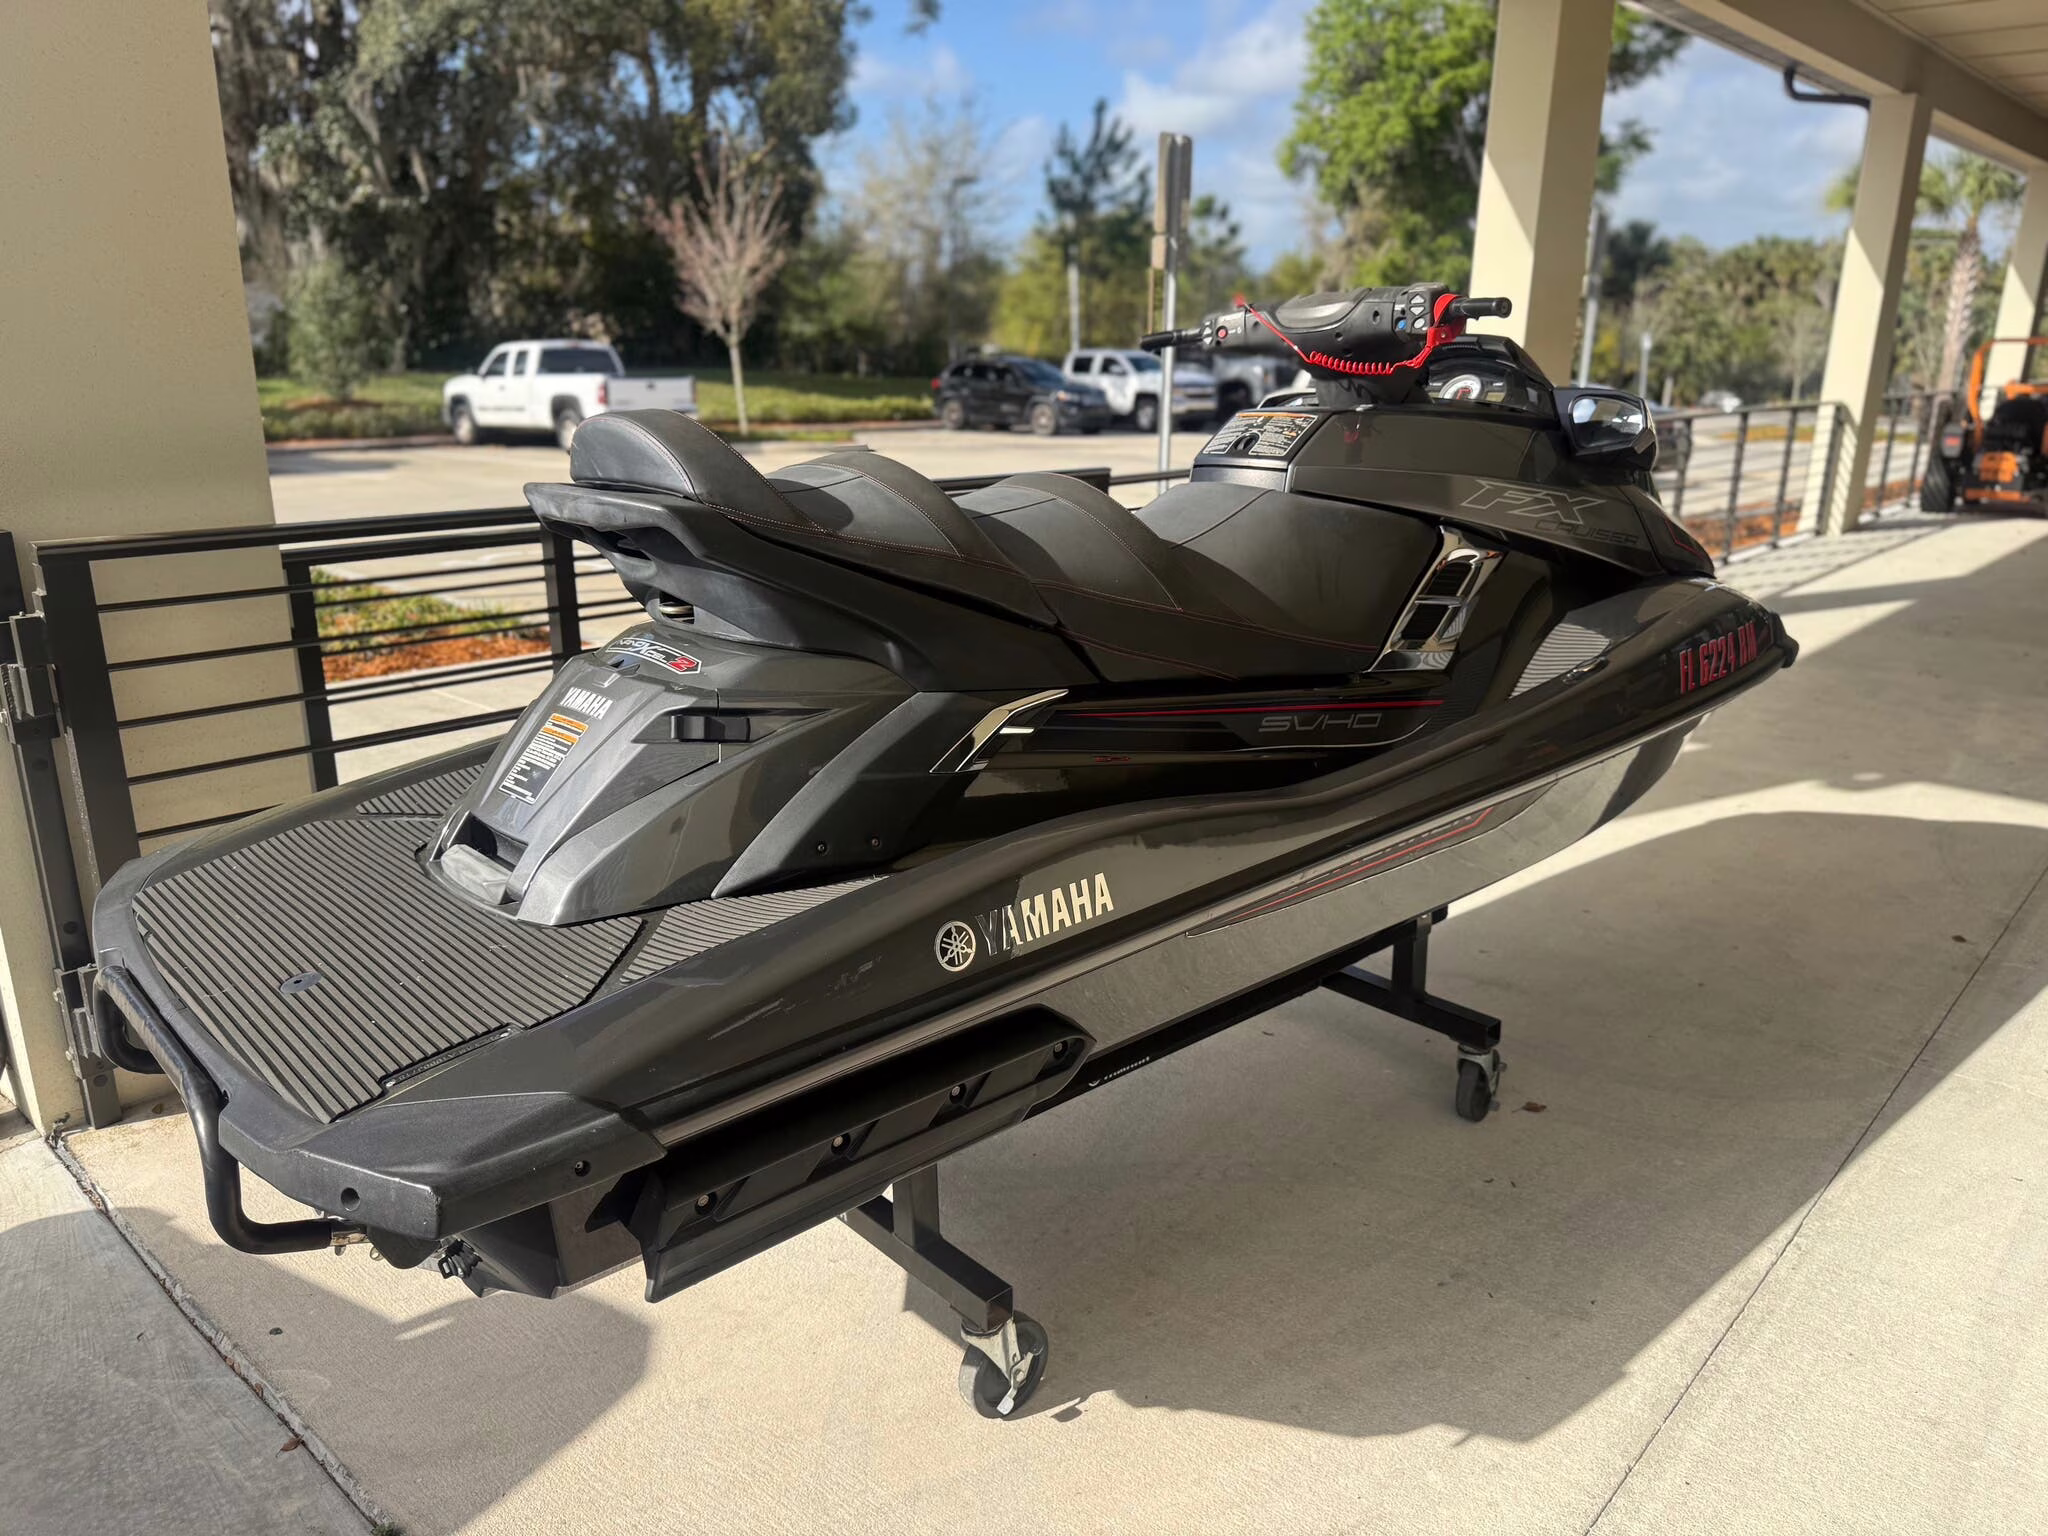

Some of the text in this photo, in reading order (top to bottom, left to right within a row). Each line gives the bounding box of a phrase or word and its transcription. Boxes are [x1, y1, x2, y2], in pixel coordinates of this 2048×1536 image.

[1460, 479, 1607, 525] FX
[1534, 518, 1641, 546] CRUISER
[1680, 647, 1697, 695] FL
[1699, 631, 1737, 688] 6224
[560, 686, 614, 721] YAMAHA
[1258, 713, 1382, 733] SVHO
[974, 872, 1115, 957] YAMAHA
